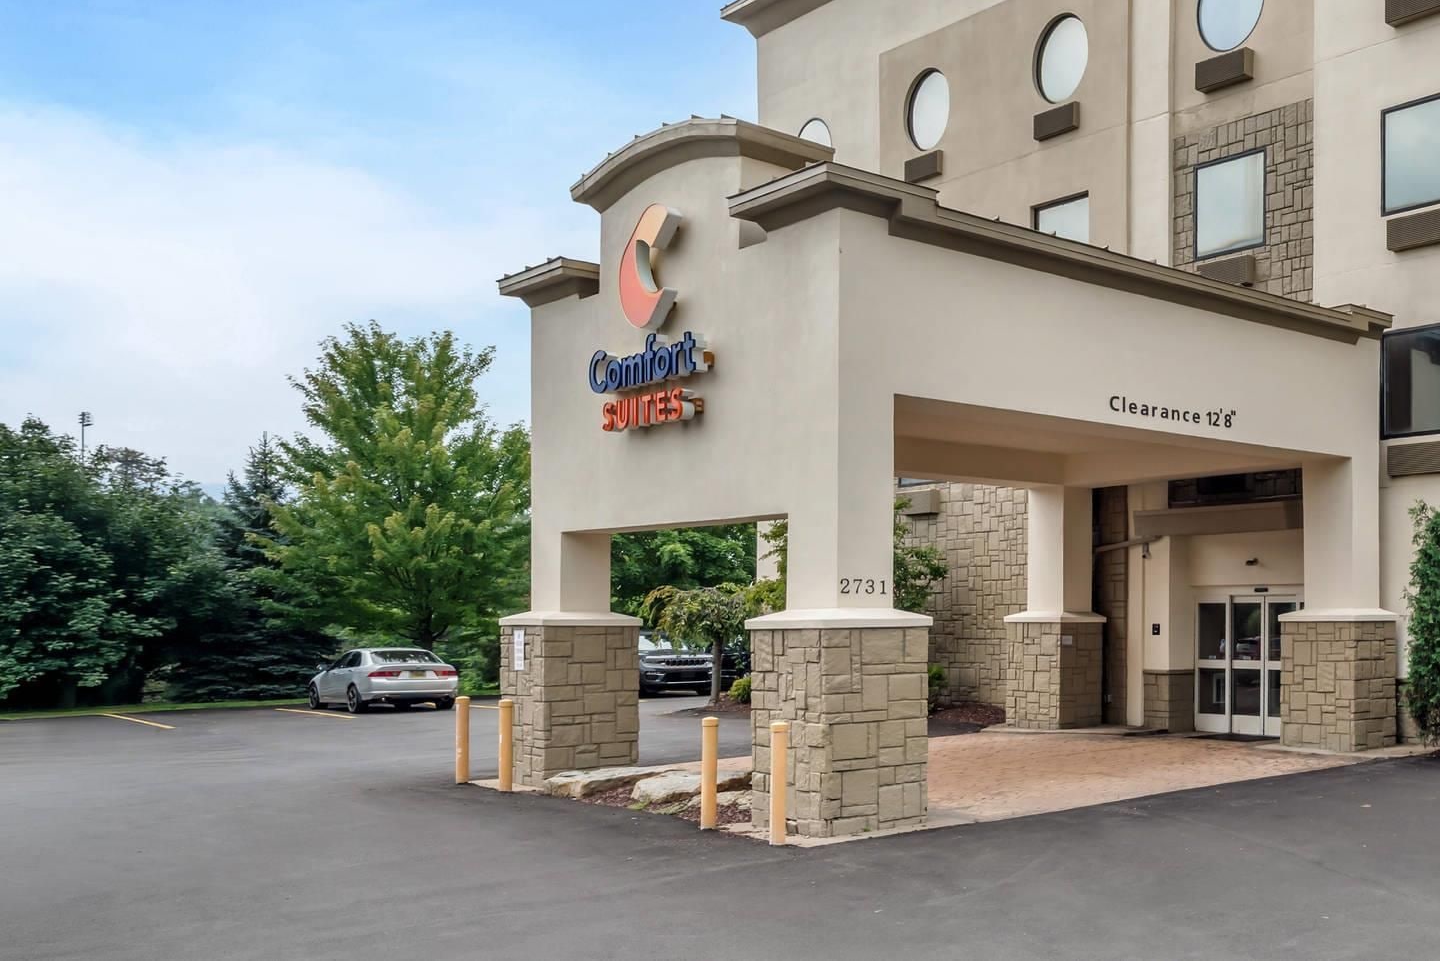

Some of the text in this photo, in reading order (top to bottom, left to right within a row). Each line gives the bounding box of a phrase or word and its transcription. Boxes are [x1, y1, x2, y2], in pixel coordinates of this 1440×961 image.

[589, 331, 696, 393] Comfort
[602, 387, 684, 431] SUITES
[1109, 395, 1201, 424] Clearance
[840, 578, 887, 594] 2731
